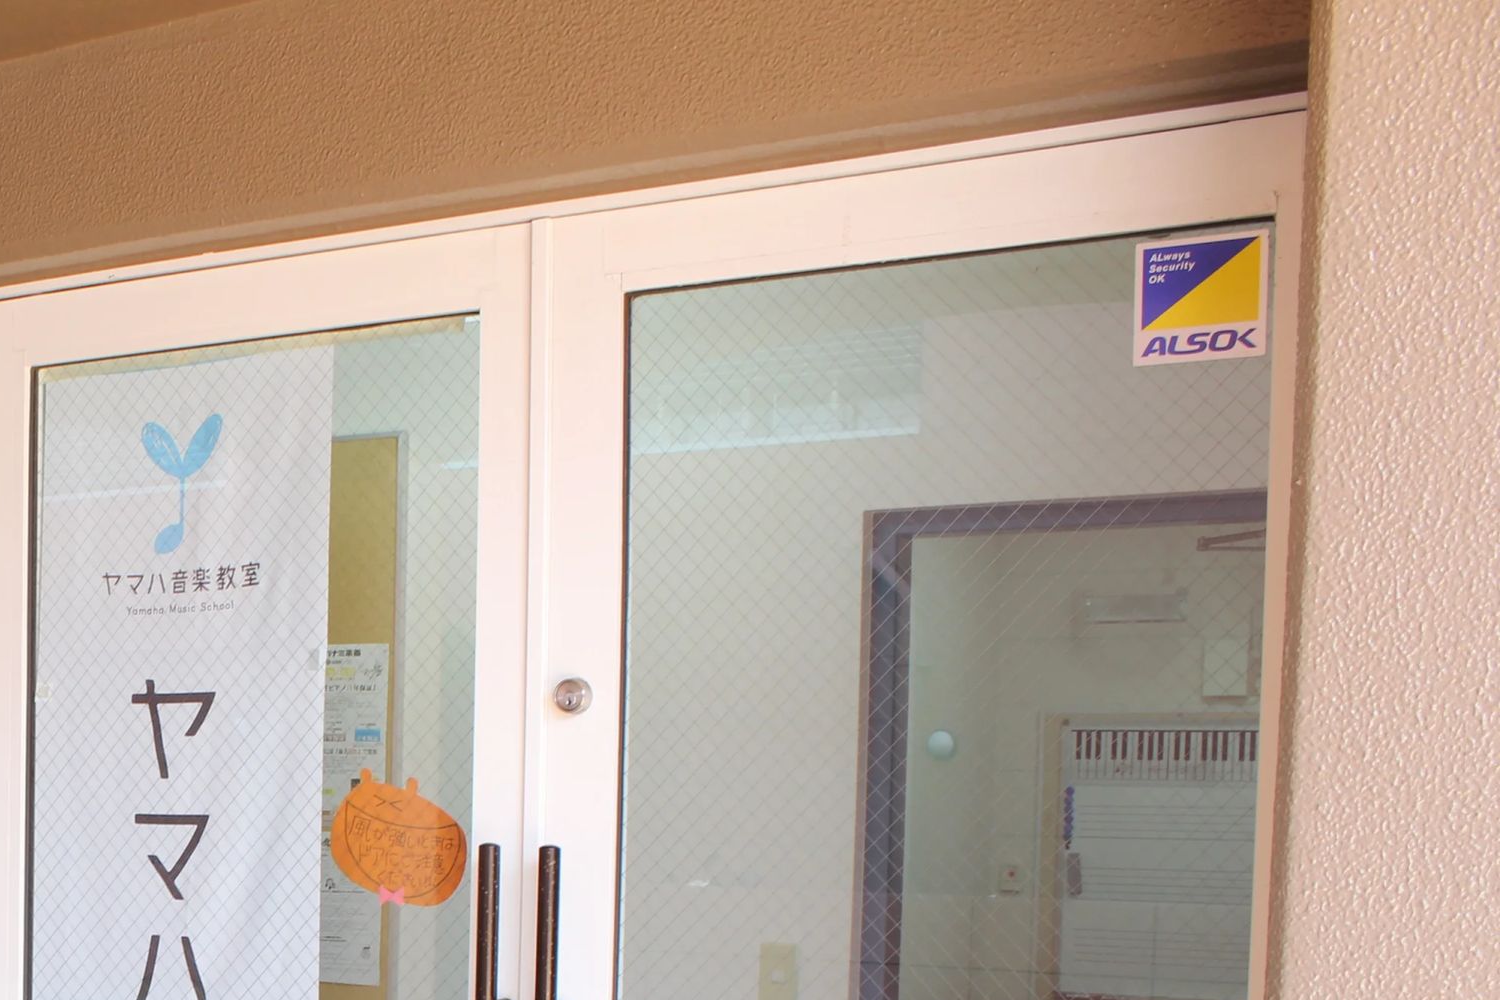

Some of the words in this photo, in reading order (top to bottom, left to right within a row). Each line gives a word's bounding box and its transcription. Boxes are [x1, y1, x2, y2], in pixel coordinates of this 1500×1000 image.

[1149, 251, 1191, 263] ALways
[1149, 261, 1196, 274] Security
[1148, 273, 1165, 284] OK
[1141, 327, 1257, 358] ALSOK
[102, 562, 261, 595] ヤマハ音楽教室
[126, 607, 165, 617] Yamaha
[169, 604, 196, 613] Music
[200, 601, 235, 612] School
